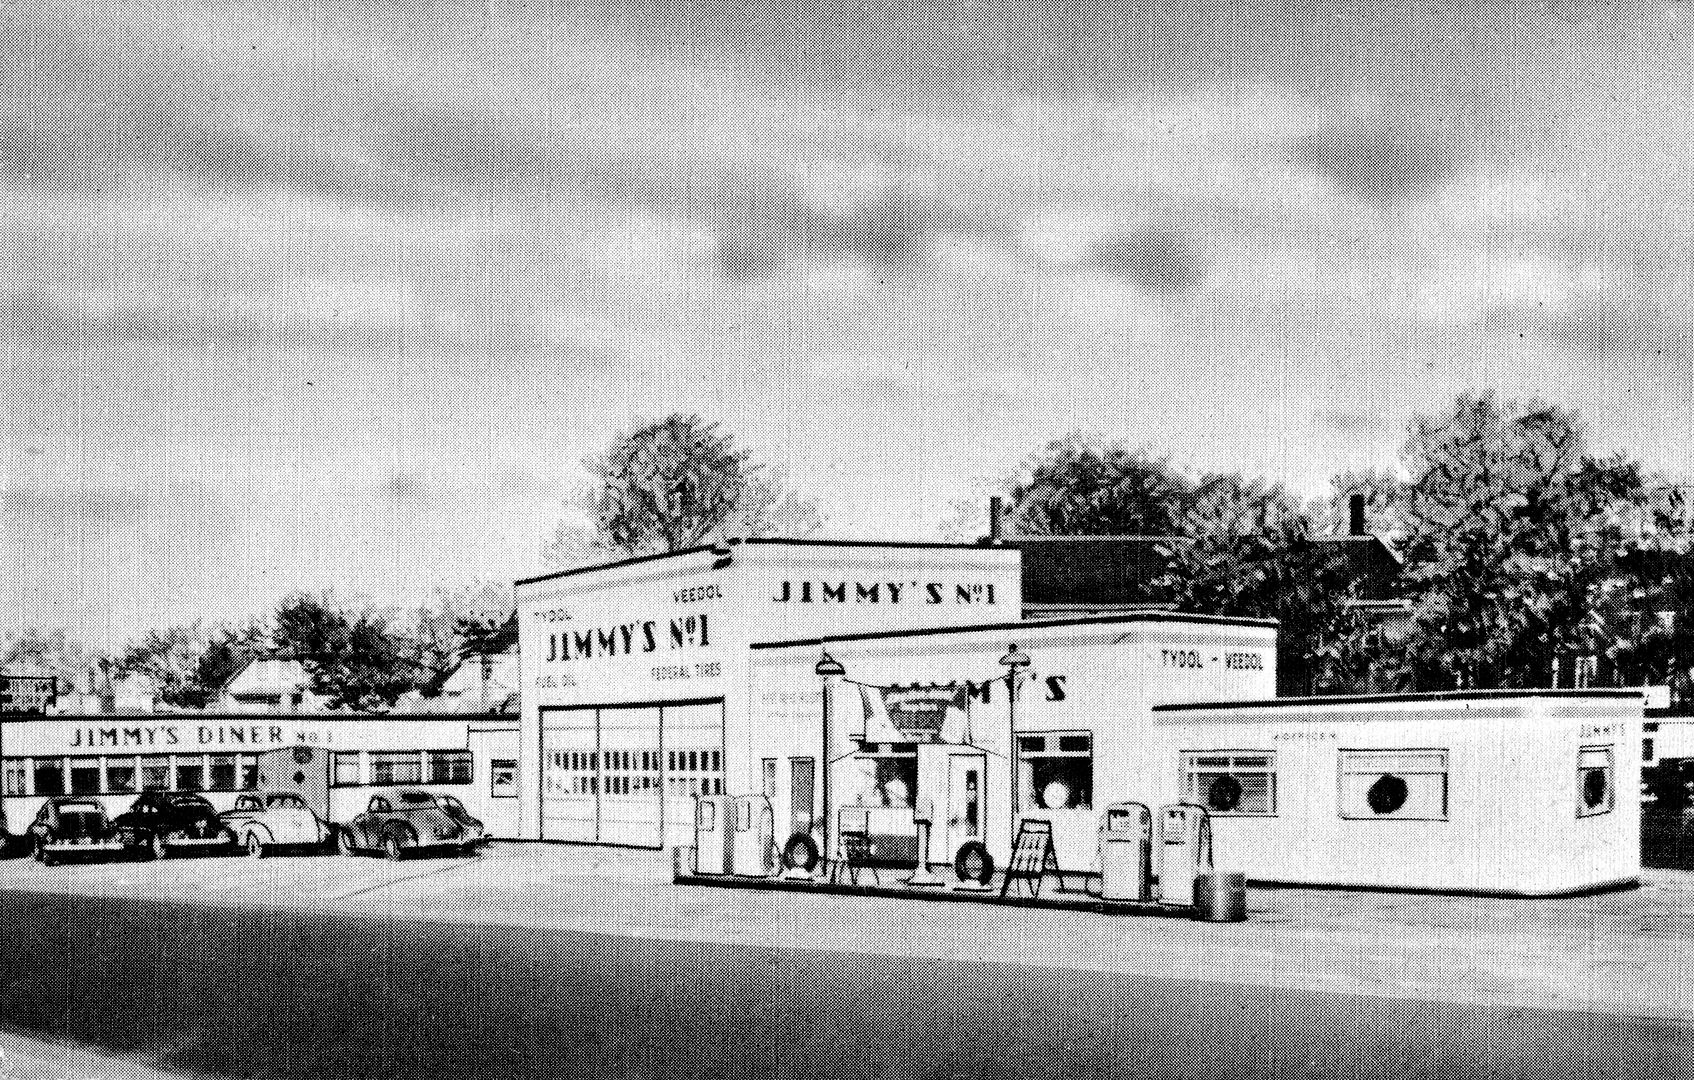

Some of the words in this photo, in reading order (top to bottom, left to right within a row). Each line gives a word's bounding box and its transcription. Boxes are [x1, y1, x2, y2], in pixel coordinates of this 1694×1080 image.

[673, 584, 723, 604] VEEDOL
[773, 580, 943, 604] JIMMY'S
[533, 607, 573, 624] TYDOL
[546, 619, 657, 662] JIMMY'S
[1161, 649, 1204, 669] TYDOL
[1224, 651, 1264, 671] VEEDOL
[534, 676, 558, 689] FUEL
[562, 673, 578, 687] OIL
[650, 665, 691, 681] FEDERAL
[694, 661, 722, 677] TIRES
[70, 726, 179, 747] JIMMY'S
[197, 725, 284, 744] DINER
